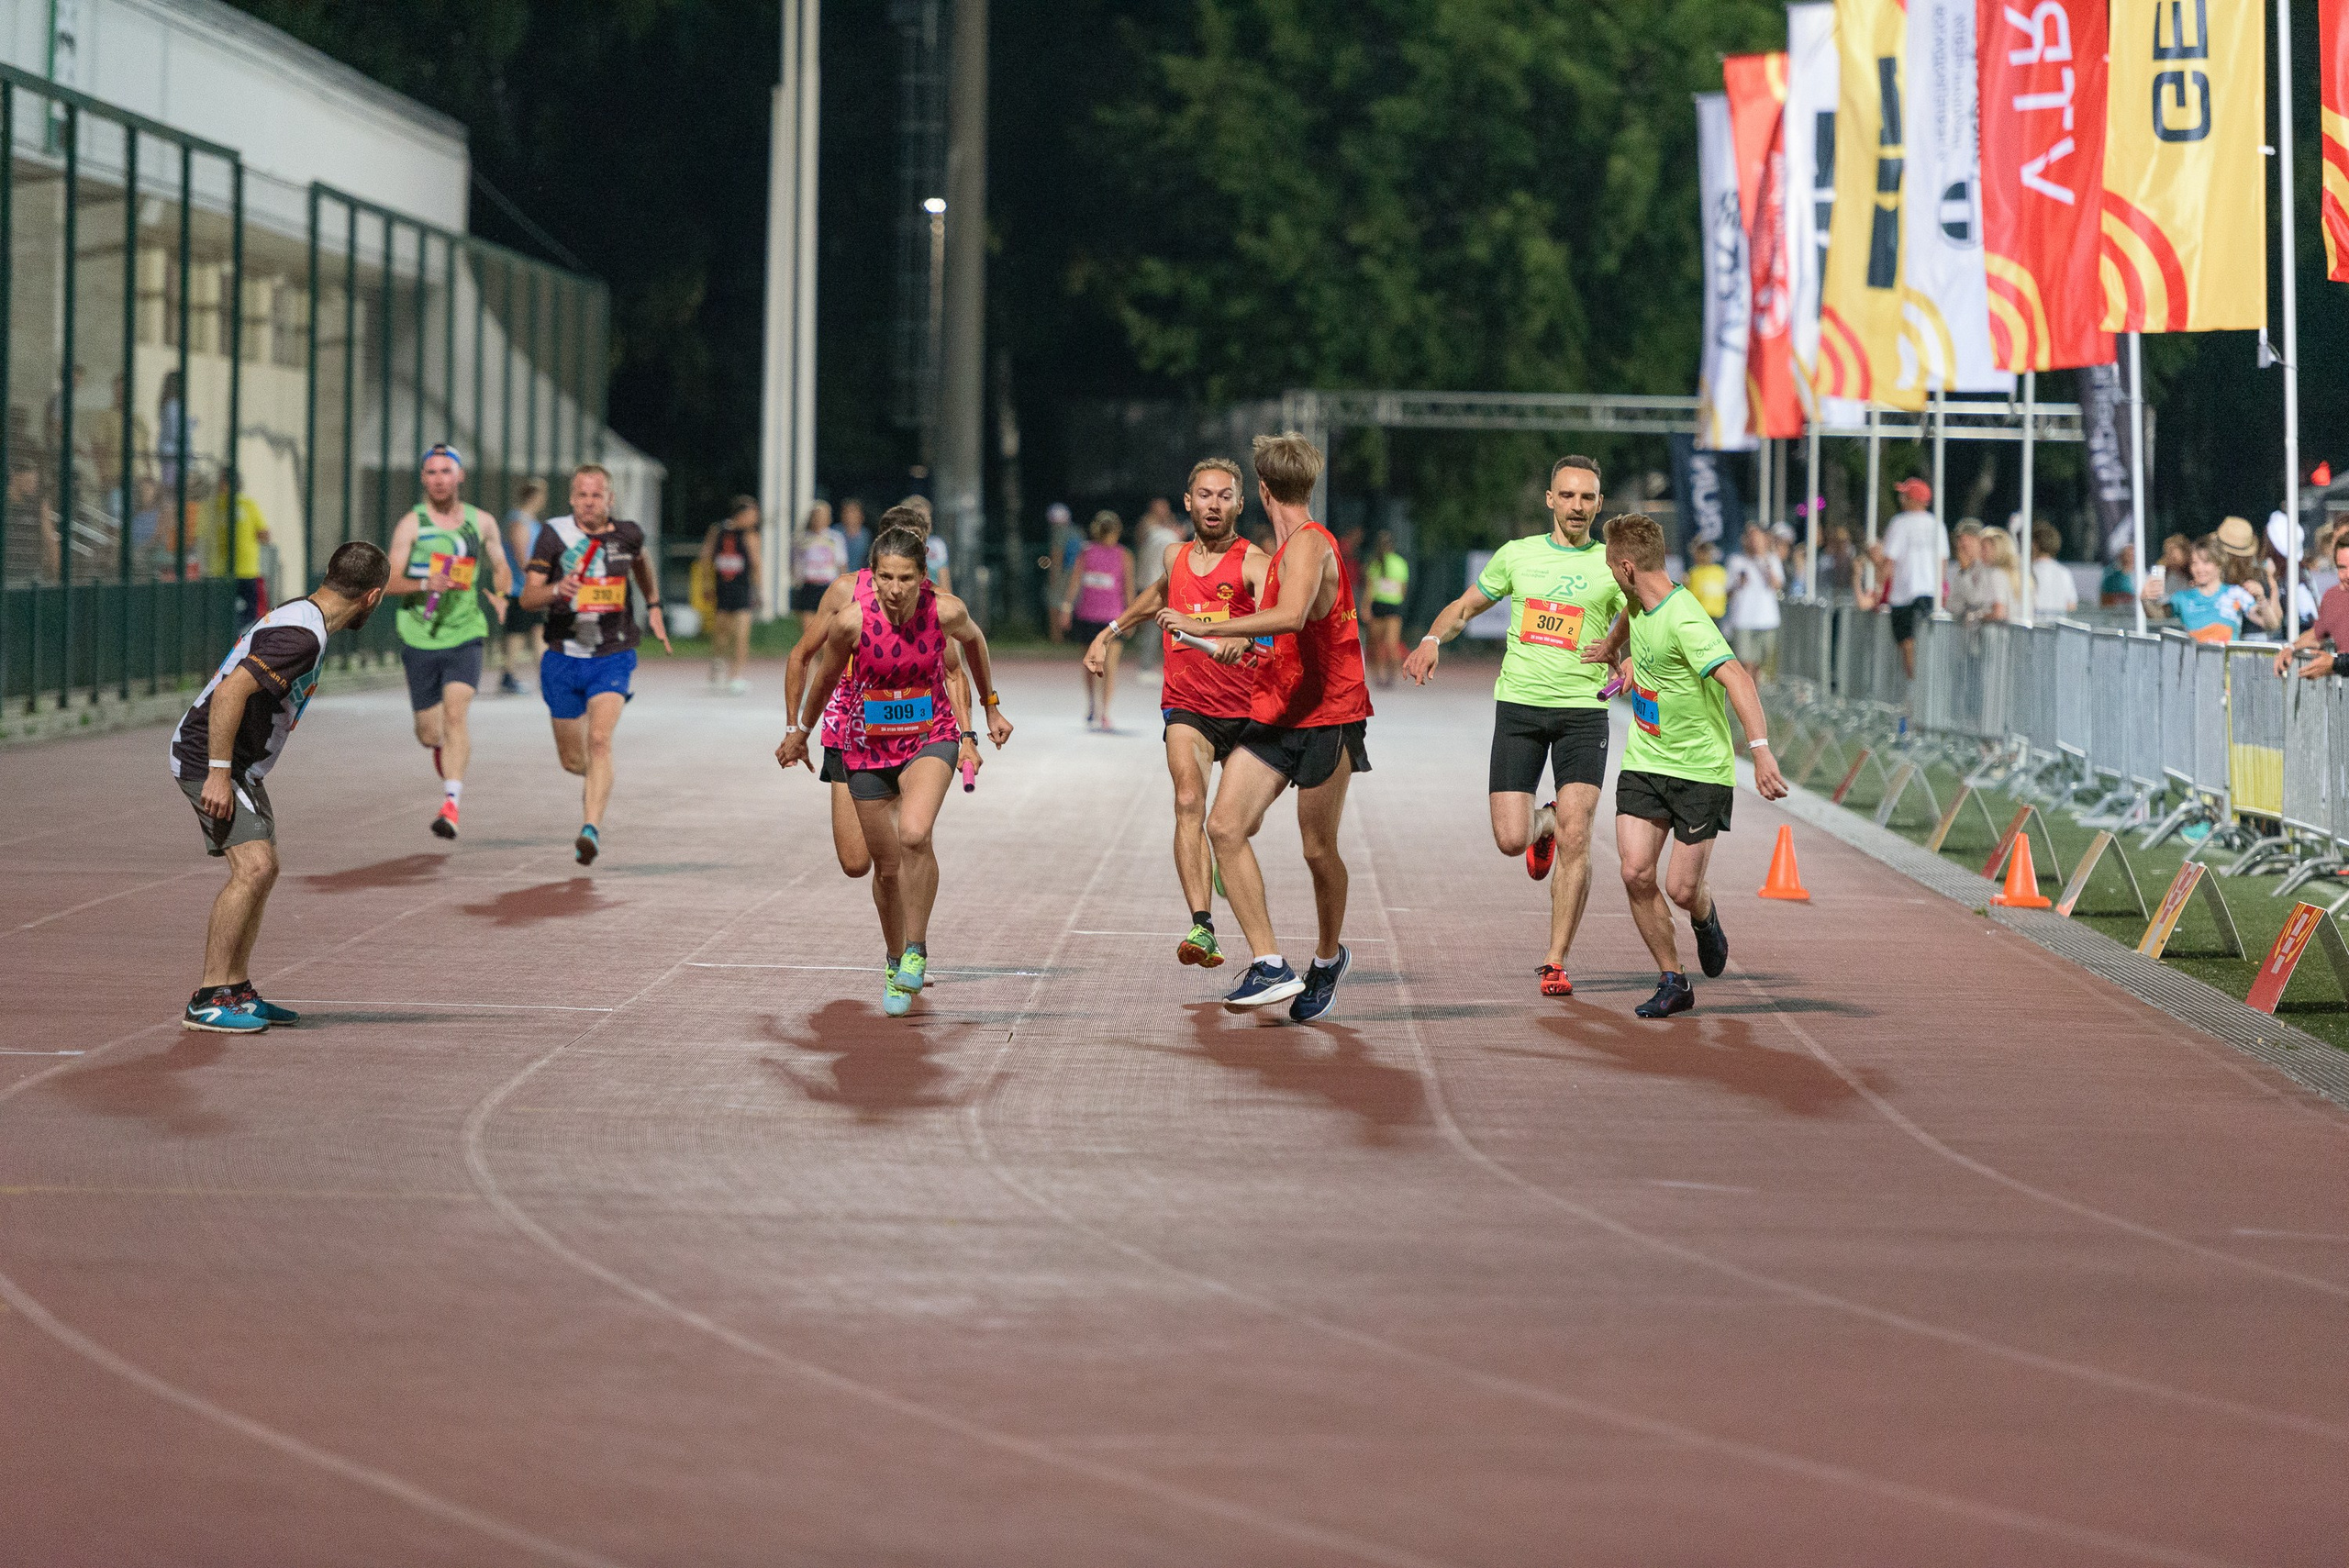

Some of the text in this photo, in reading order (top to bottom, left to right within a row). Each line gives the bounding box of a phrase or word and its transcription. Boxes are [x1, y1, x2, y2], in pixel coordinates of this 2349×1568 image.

[593, 589, 612, 601] 310
[1537, 615, 1574, 635] 307 2
[883, 703, 926, 720] 309 3
[1650, 711, 1654, 720] 3
